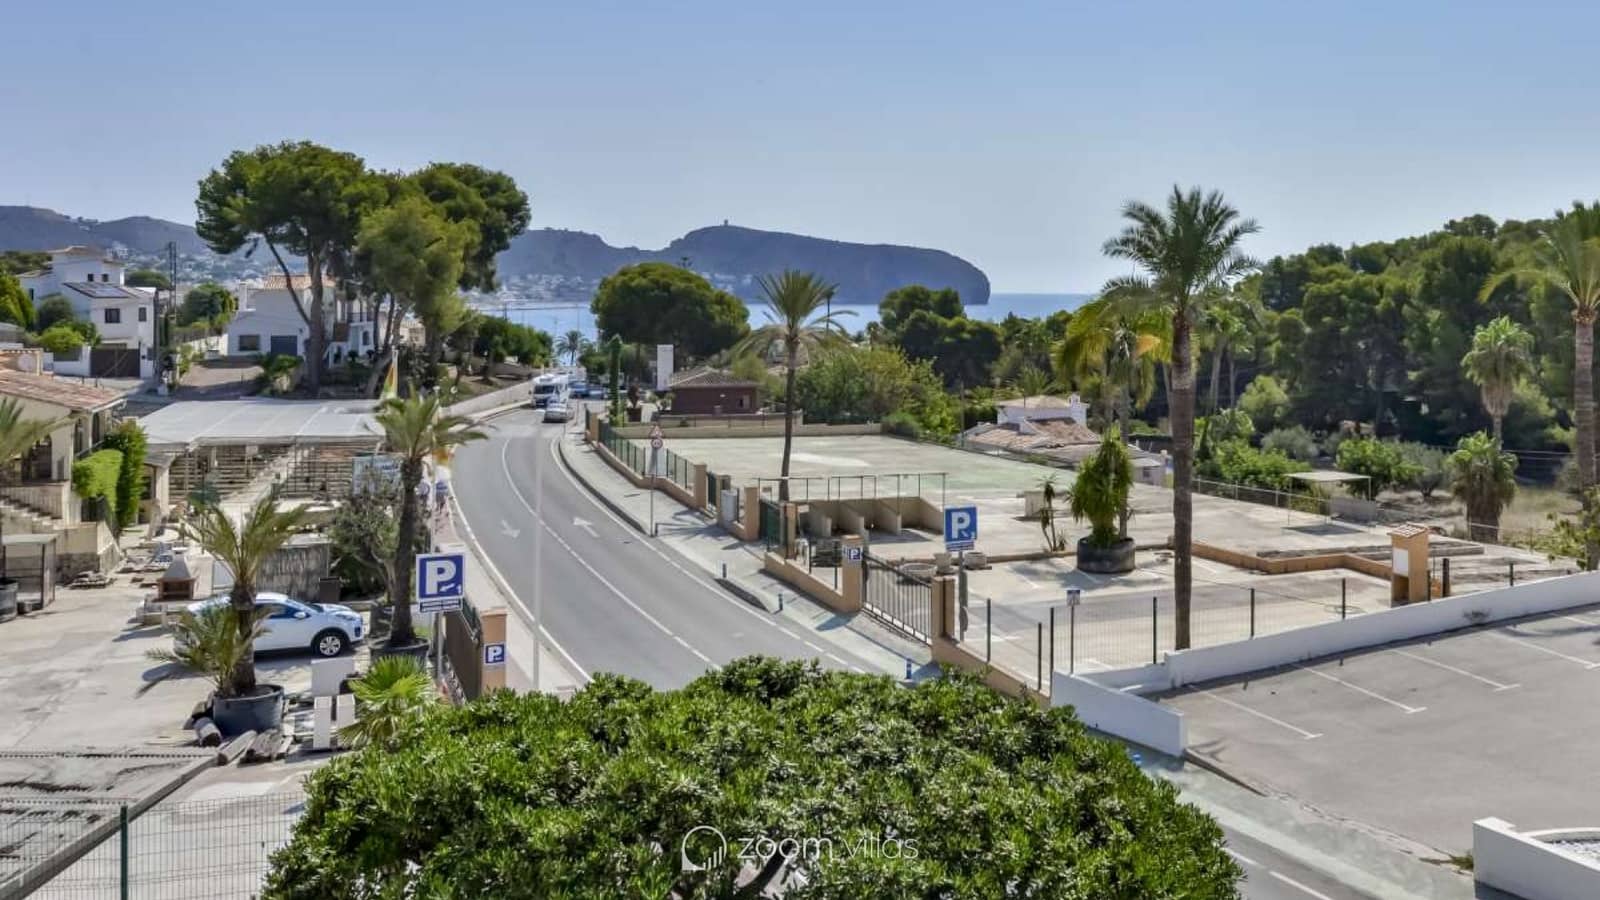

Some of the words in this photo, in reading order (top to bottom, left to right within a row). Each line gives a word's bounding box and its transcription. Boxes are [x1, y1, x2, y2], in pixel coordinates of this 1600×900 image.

[951, 511, 971, 539] P
[850, 548, 860, 559] P
[425, 559, 457, 595] P
[487, 646, 503, 662] P
